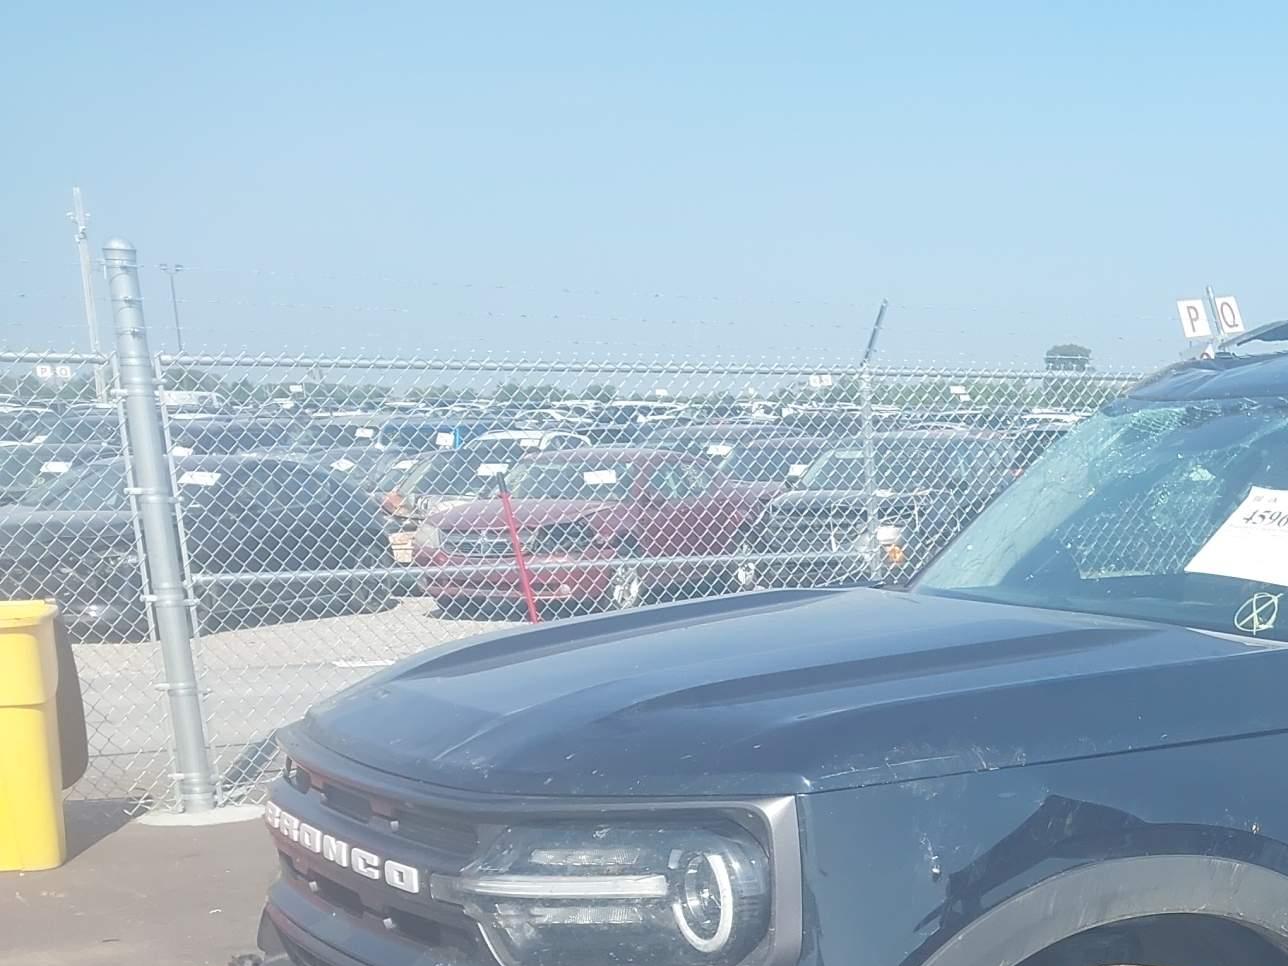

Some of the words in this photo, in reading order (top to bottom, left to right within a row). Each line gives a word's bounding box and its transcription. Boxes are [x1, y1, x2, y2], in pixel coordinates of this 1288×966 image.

[1186, 305, 1200, 333] P
[1220, 301, 1239, 328] Q
[265, 800, 419, 893] BRONCO
